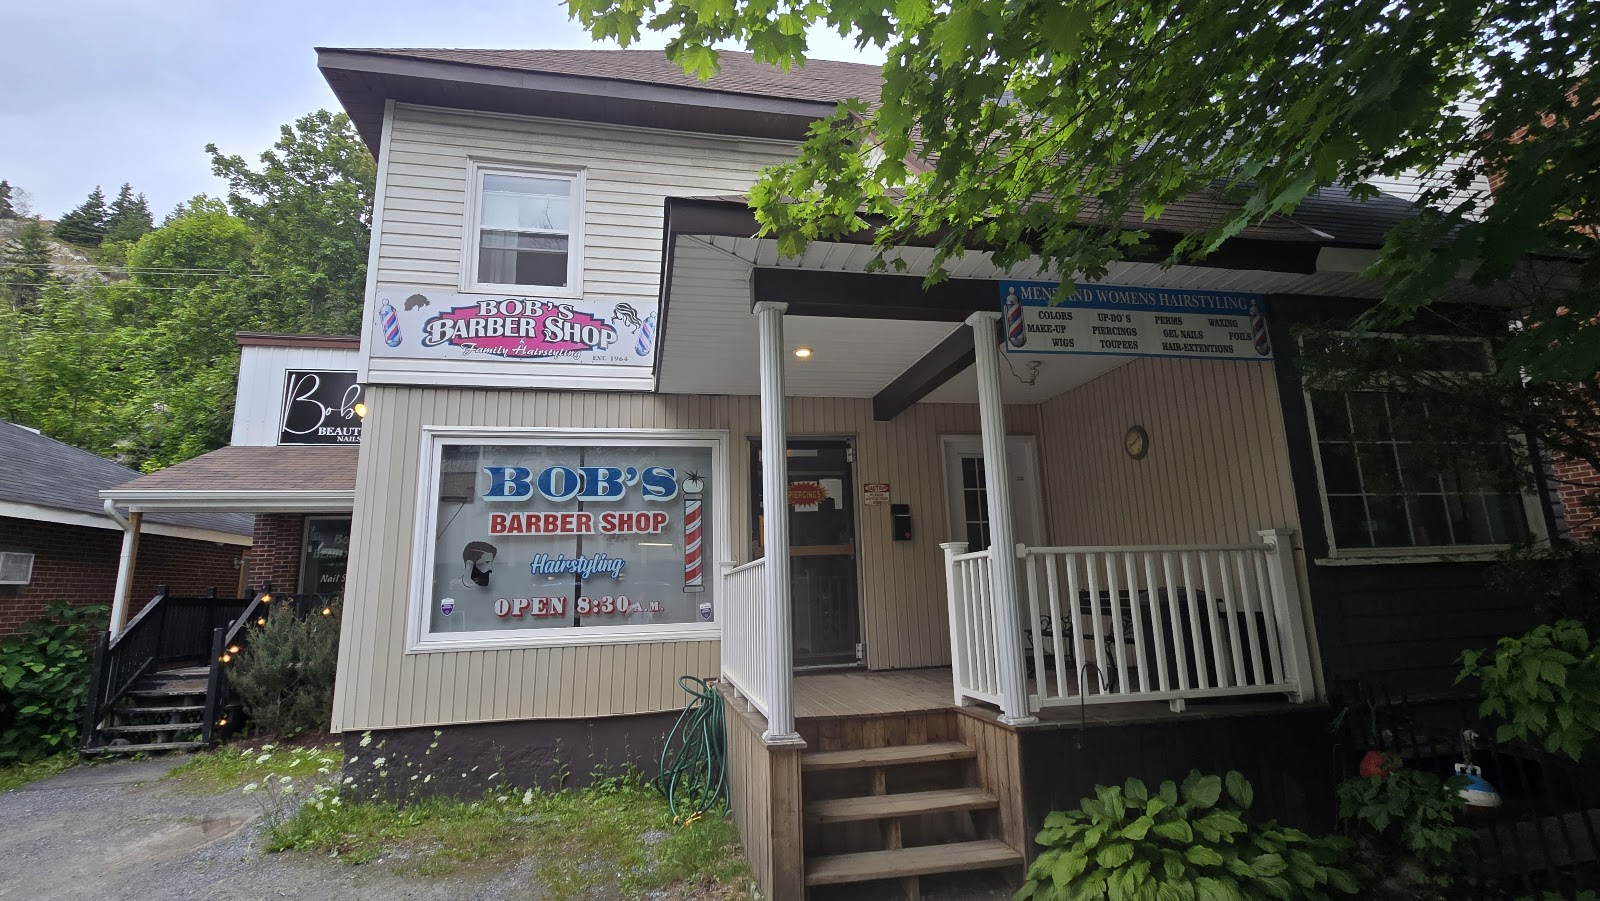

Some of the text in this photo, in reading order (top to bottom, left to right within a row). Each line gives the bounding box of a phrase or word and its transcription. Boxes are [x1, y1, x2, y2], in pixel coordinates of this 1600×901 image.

[477, 299, 575, 320] BOB'S
[1096, 290, 1156, 306] WOMENS
[1158, 293, 1248, 311] HAIRSTYLING
[1038, 310, 1073, 321] COLORS
[1154, 316, 1183, 326] PERMS
[1208, 318, 1238, 328] WAXING
[424, 318, 618, 349] BARBER SHOP
[1027, 323, 1252, 341] MAKE-UP PIERCINGS GEL NAILS FOILS
[460, 342, 582, 360] Family Hairstyling
[1052, 338, 1234, 354] WIGS TOUPEES HAIR-EXTENTIONS
[281, 373, 363, 434] Bob
[317, 427, 362, 436] BEAUT
[481, 464, 679, 502] BOB'S
[788, 490, 821, 499] PIERCINGS
[488, 511, 669, 536] BARBER SHOP
[334, 534, 349, 544] Bo
[530, 553, 625, 580] Hairstyling
[320, 573, 347, 583] Nail S
[493, 595, 665, 618] OPEN 8:30 A.M.
